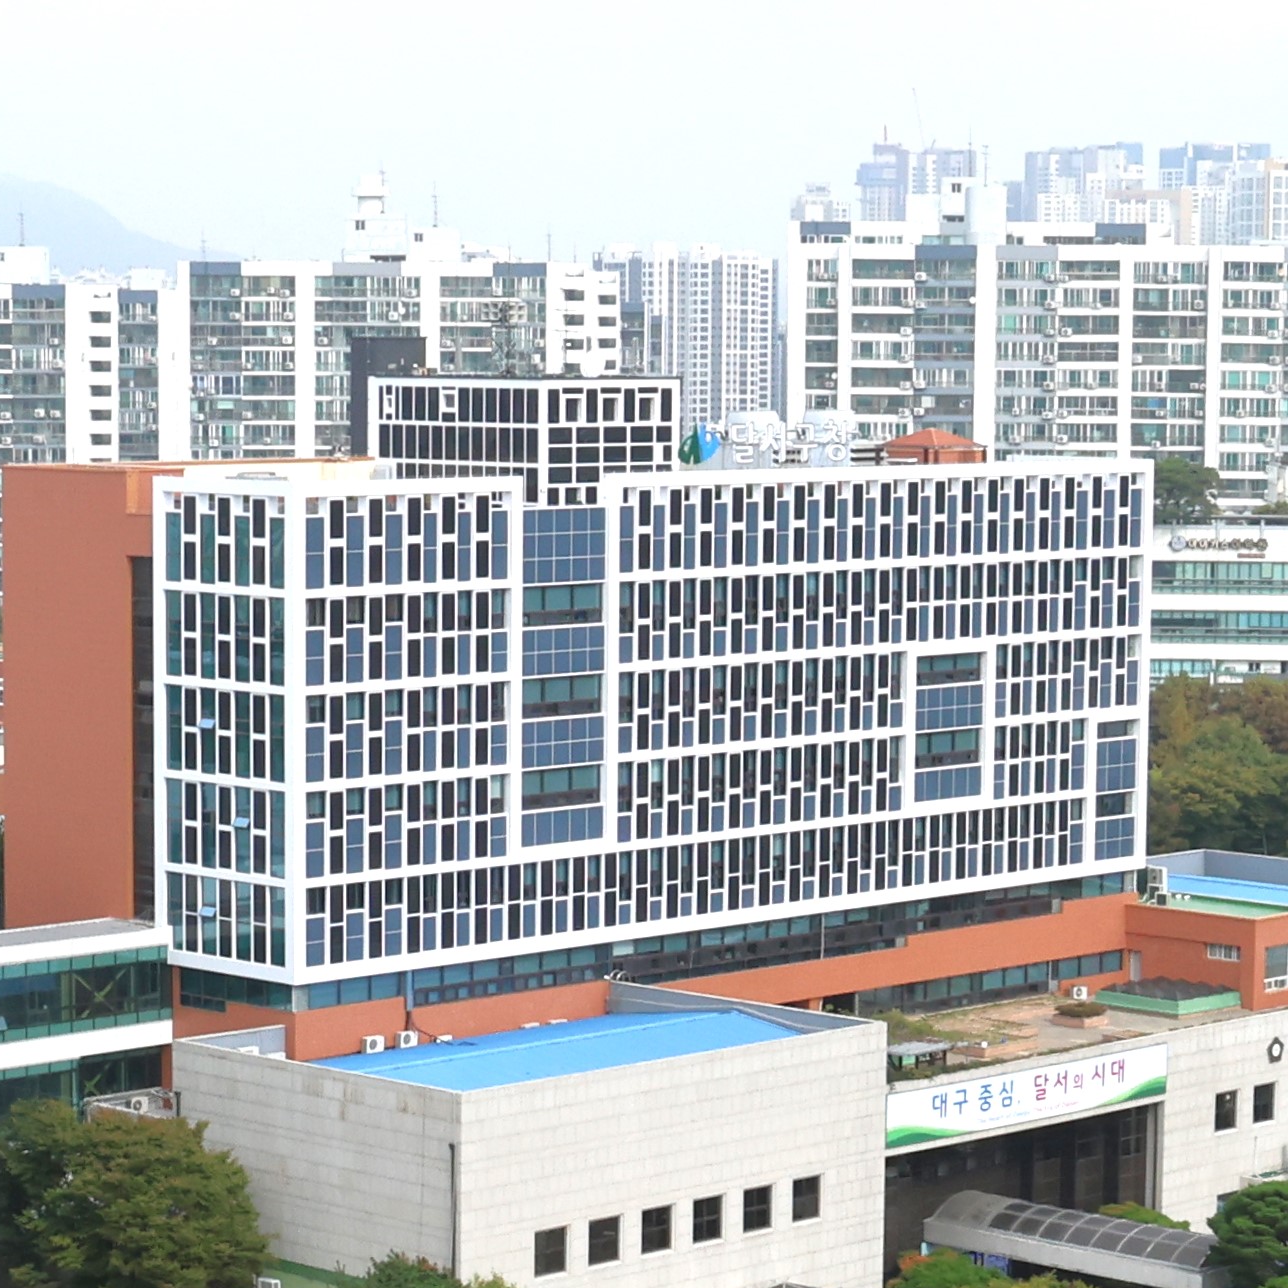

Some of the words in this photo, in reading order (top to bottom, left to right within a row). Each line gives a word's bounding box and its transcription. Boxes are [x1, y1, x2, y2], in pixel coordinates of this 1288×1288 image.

[730, 419, 848, 465] 달서구청
[931, 1088, 969, 1119] 대구
[1033, 1069, 1085, 1102] 달서의
[1091, 1058, 1127, 1087] 시대
